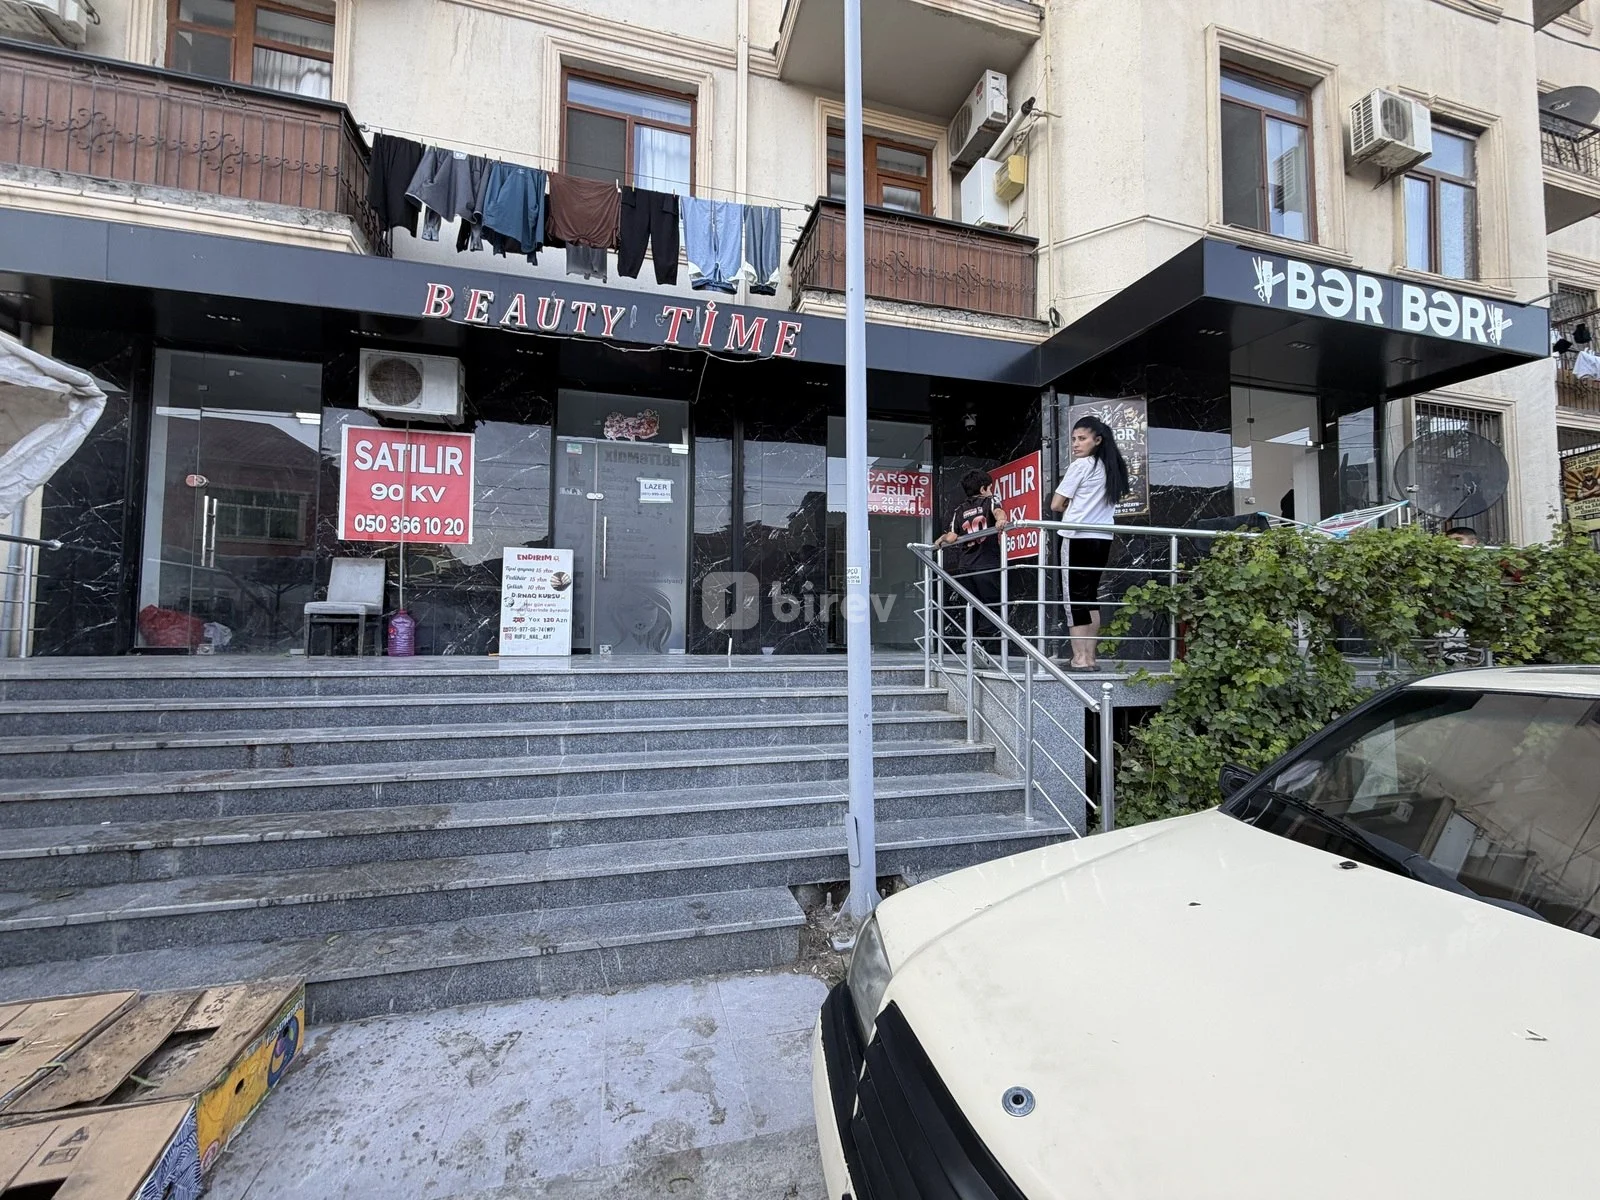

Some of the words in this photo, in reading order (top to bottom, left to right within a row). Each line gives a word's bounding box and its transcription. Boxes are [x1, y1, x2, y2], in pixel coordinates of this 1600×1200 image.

[1287, 260, 1384, 324] BƏR
[1402, 284, 1489, 343] BƏR
[423, 282, 626, 337] BEAUTY
[662, 300, 802, 358] TİME
[353, 440, 464, 476] SATILIR
[644, 483, 668, 491] LAZER
[867, 471, 929, 486] CARƏYƏ
[993, 465, 1035, 502] ATILIR
[370, 483, 404, 501] 90
[411, 485, 446, 503] KV
[881, 497, 894, 505] 20
[867, 504, 878, 512] 50
[881, 504, 900, 513] 366
[918, 507, 931, 515] 20
[354, 514, 387, 533] 050
[390, 516, 421, 534] 366
[424, 517, 441, 535] 10
[444, 518, 464, 536] 20
[1007, 536, 1016, 552] 66
[1017, 533, 1026, 550] 10
[1027, 530, 1038, 548] 20
